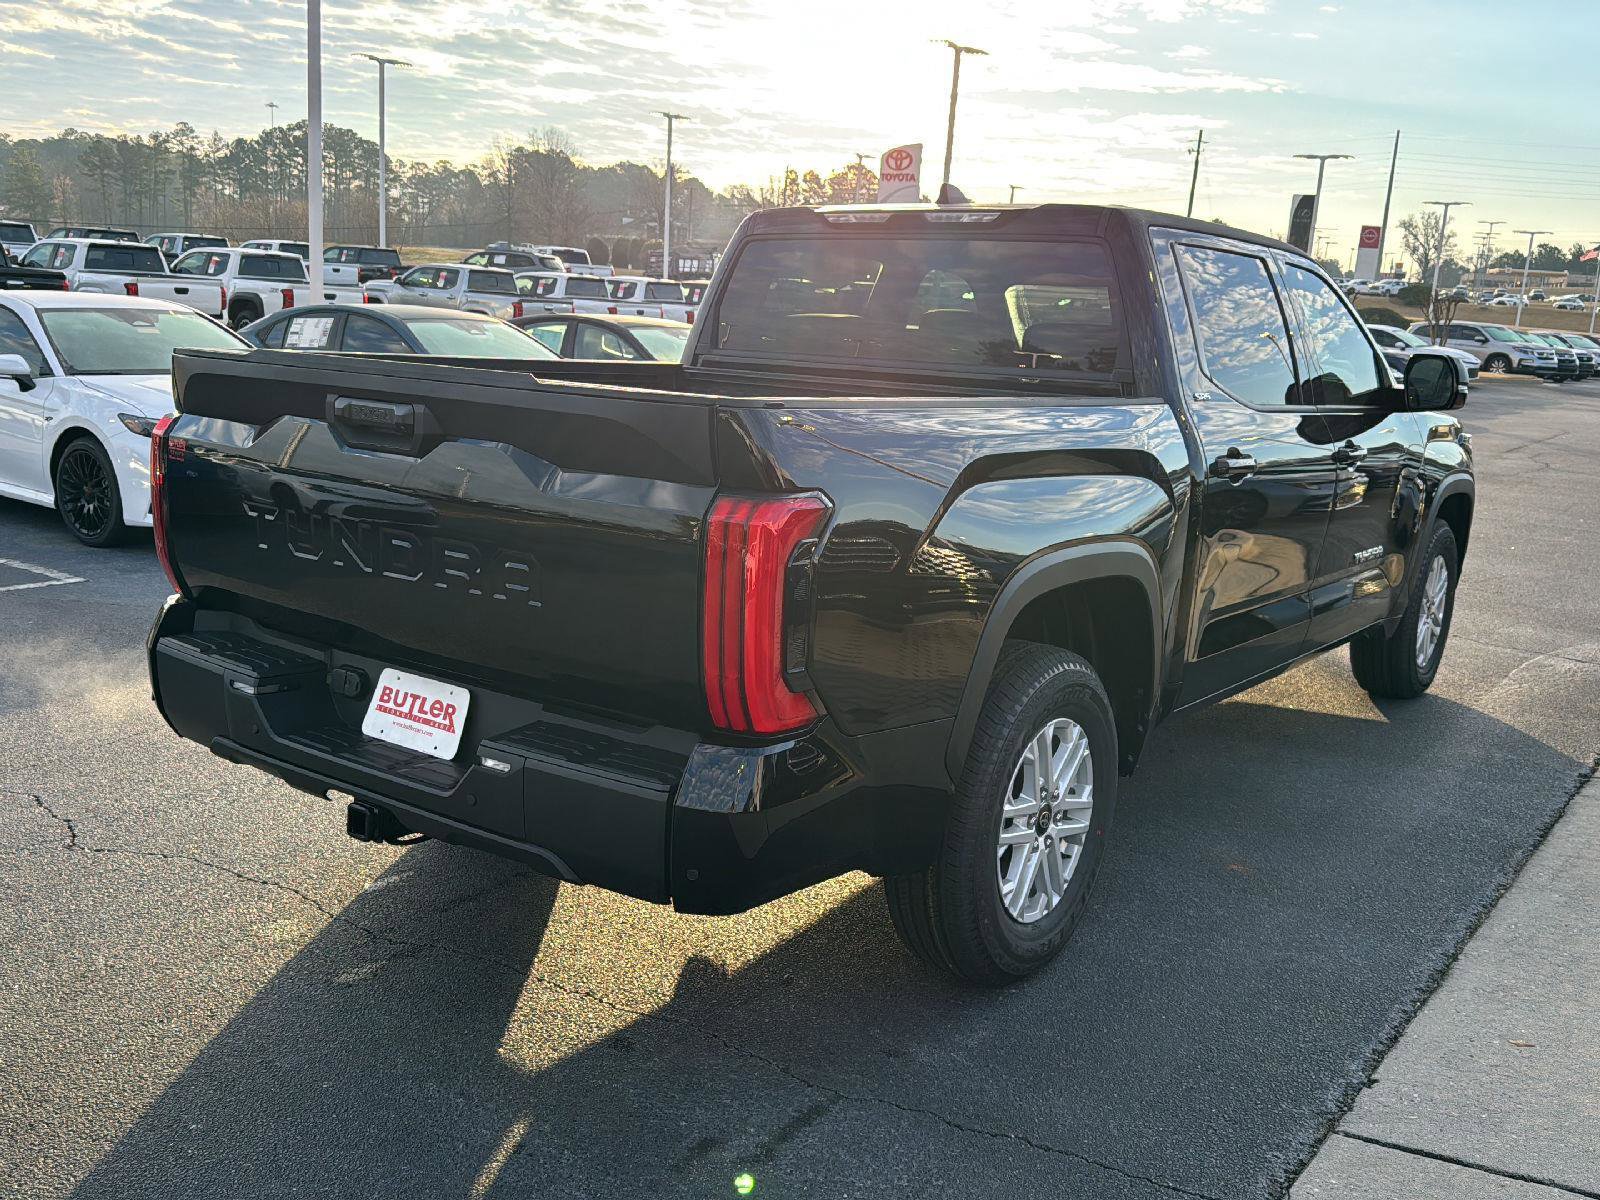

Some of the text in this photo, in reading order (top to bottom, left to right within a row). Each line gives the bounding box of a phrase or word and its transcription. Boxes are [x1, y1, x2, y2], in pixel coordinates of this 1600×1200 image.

[881, 173, 916, 182] TOYOTA
[242, 495, 544, 608] TUNDRA
[378, 685, 457, 728] BUTLER
